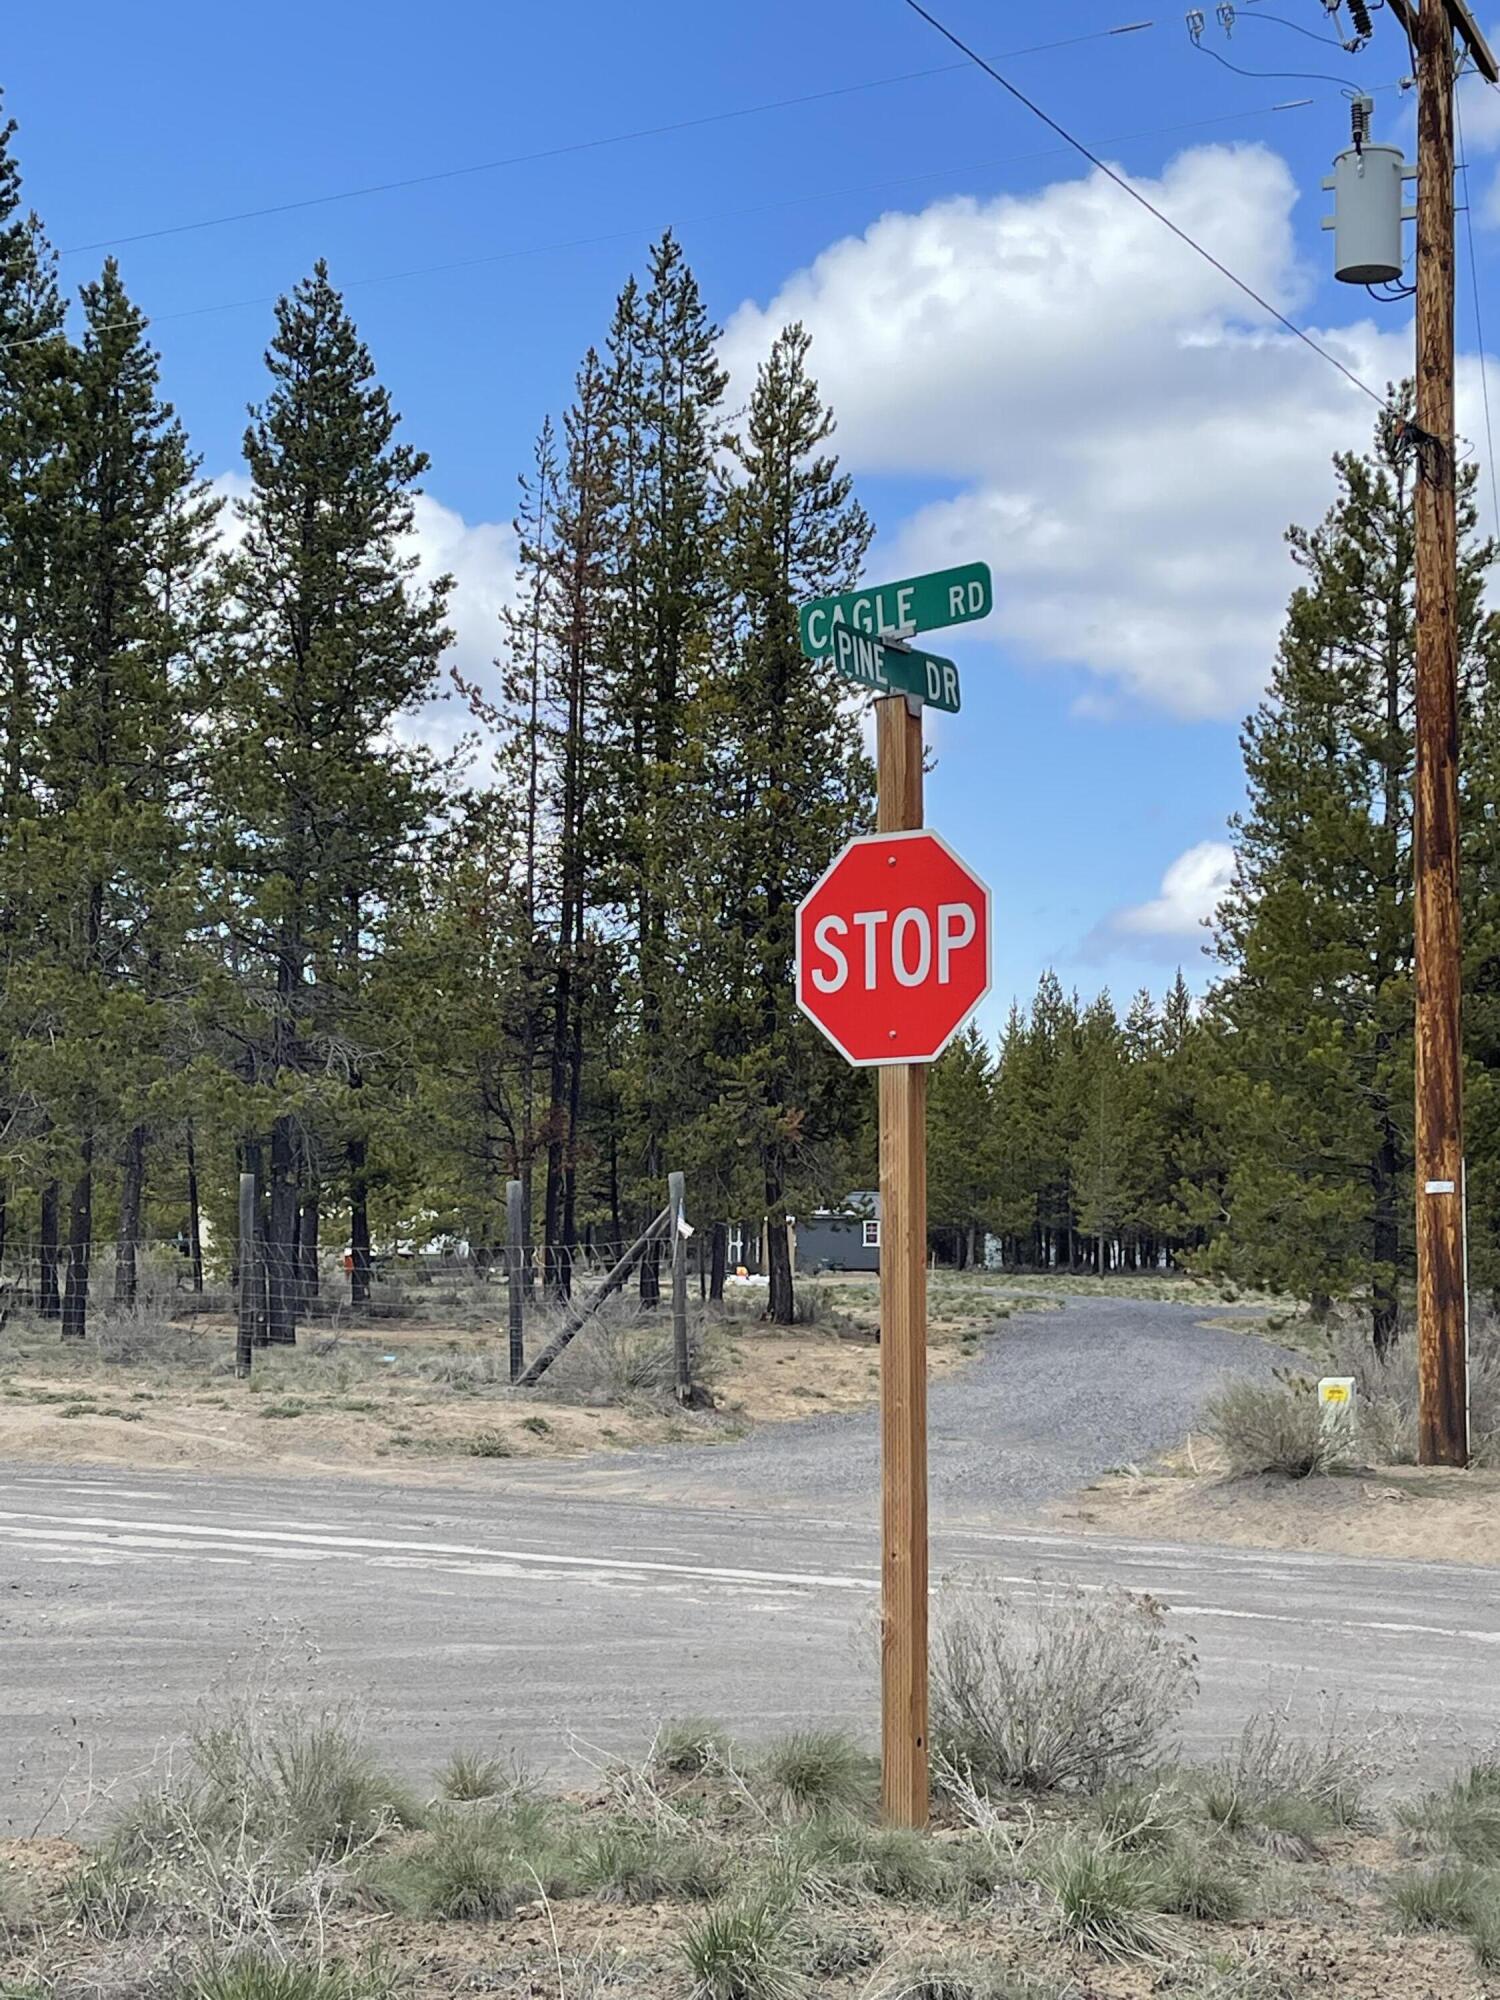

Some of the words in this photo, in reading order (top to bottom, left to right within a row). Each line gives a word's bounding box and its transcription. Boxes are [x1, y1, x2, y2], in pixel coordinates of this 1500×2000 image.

[949, 581, 984, 618] RD
[838, 630, 889, 685] PINE
[925, 661, 958, 707] DR
[811, 902, 976, 993] STOP
